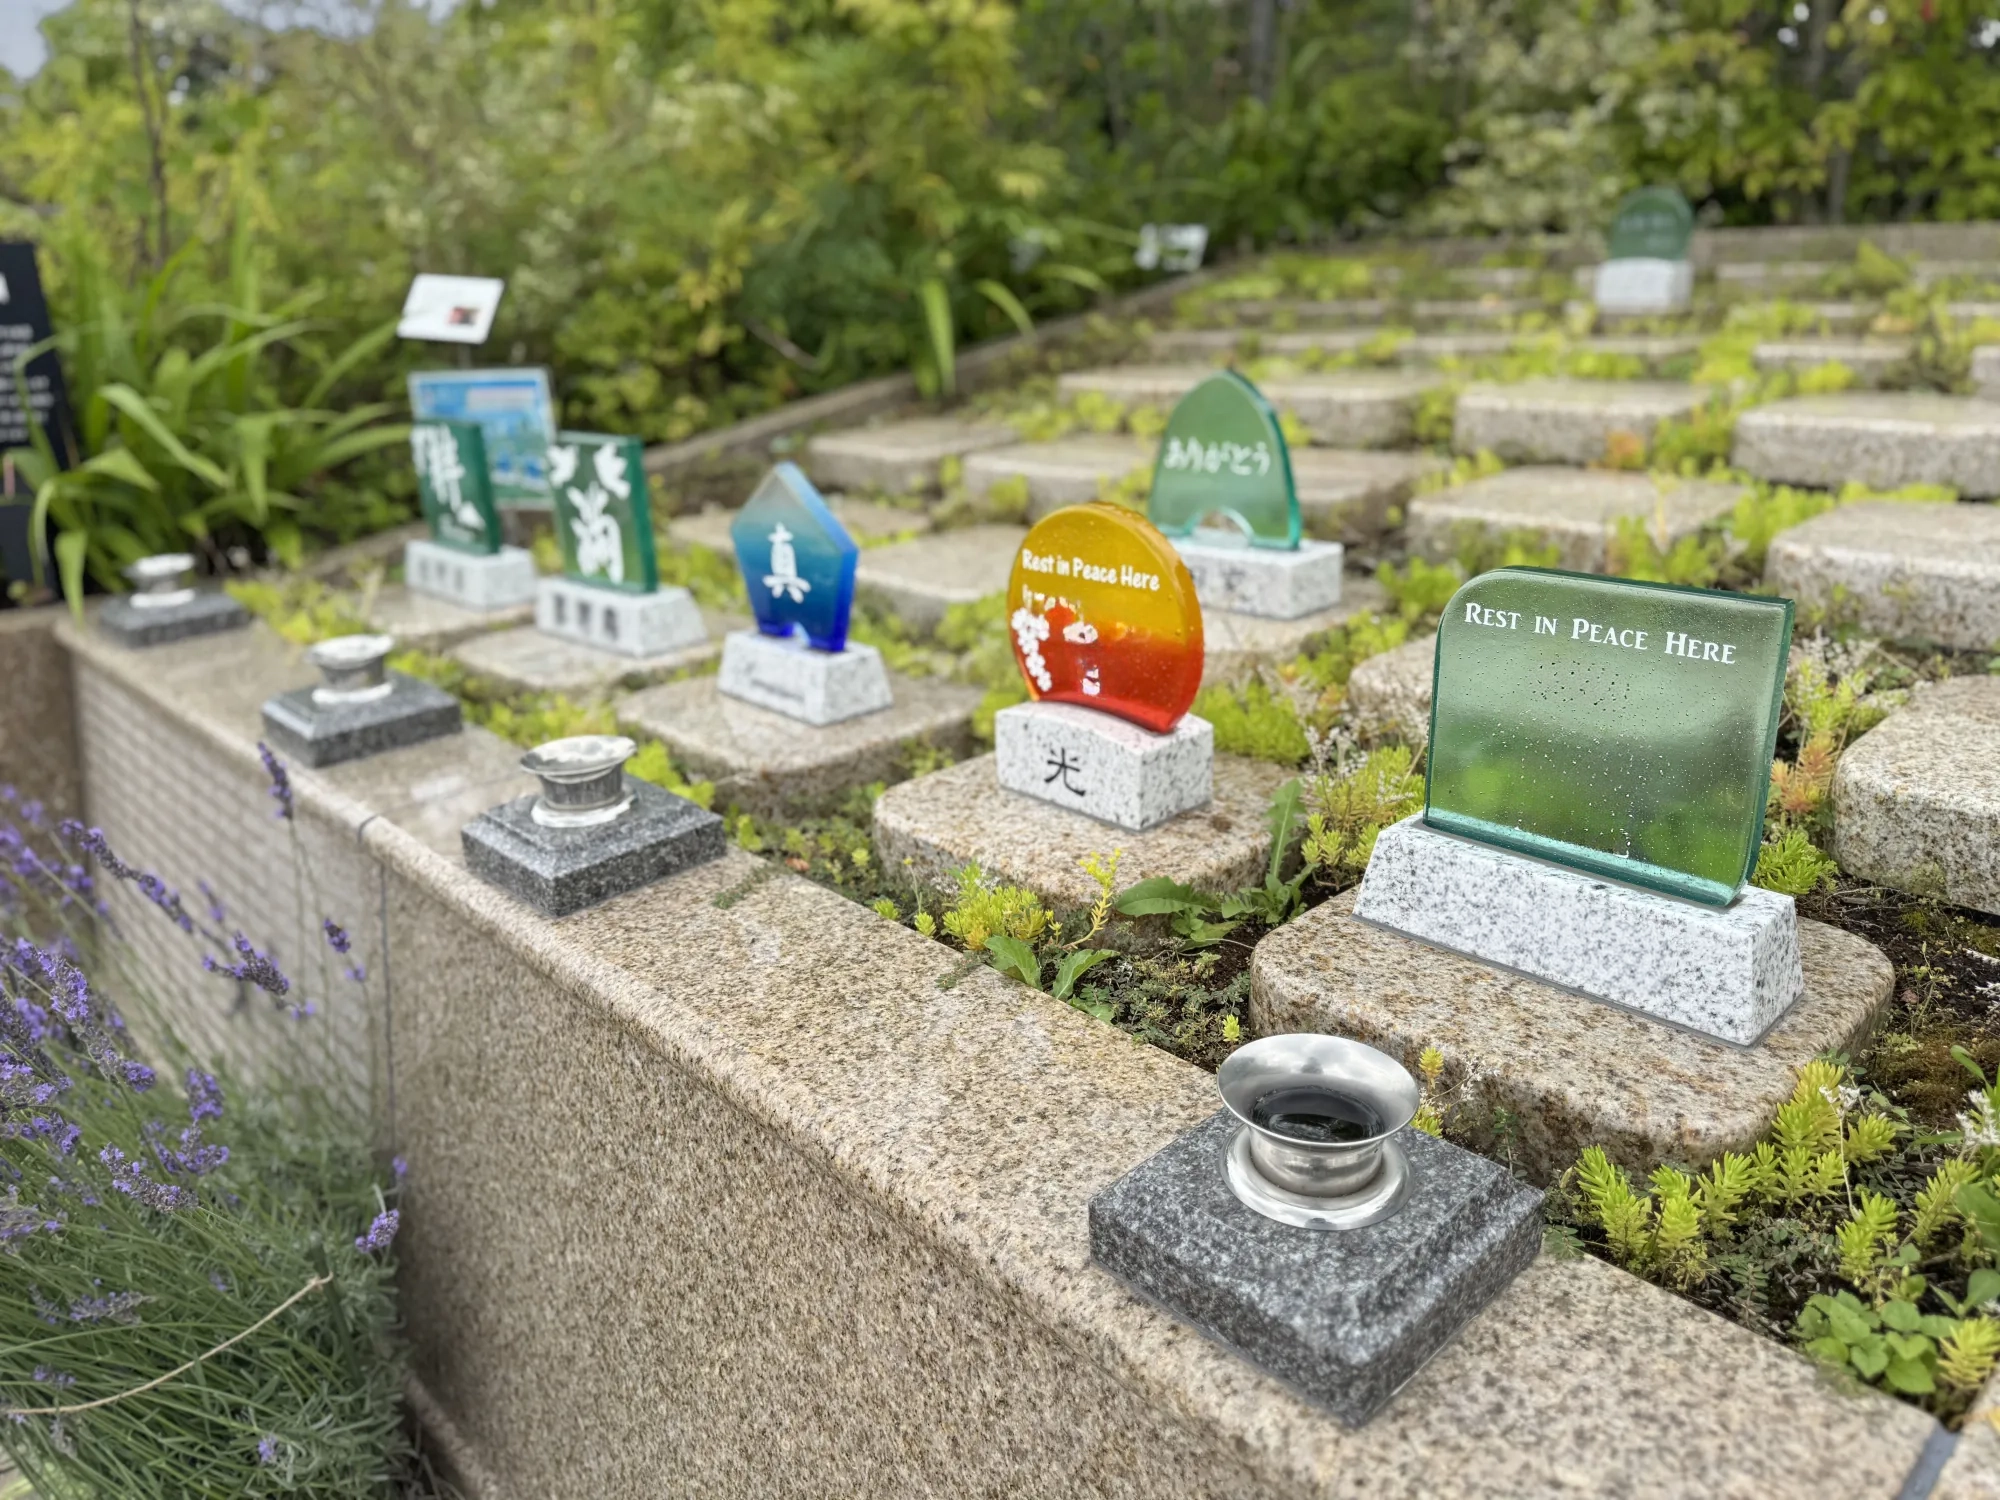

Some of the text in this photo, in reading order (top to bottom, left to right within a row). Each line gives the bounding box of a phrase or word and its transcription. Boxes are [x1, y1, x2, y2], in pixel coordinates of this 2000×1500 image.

[1163, 437, 1271, 476] ありがとう
[1021, 549, 1161, 592] Rest in Peace Here
[1043, 747, 1087, 797] 光
